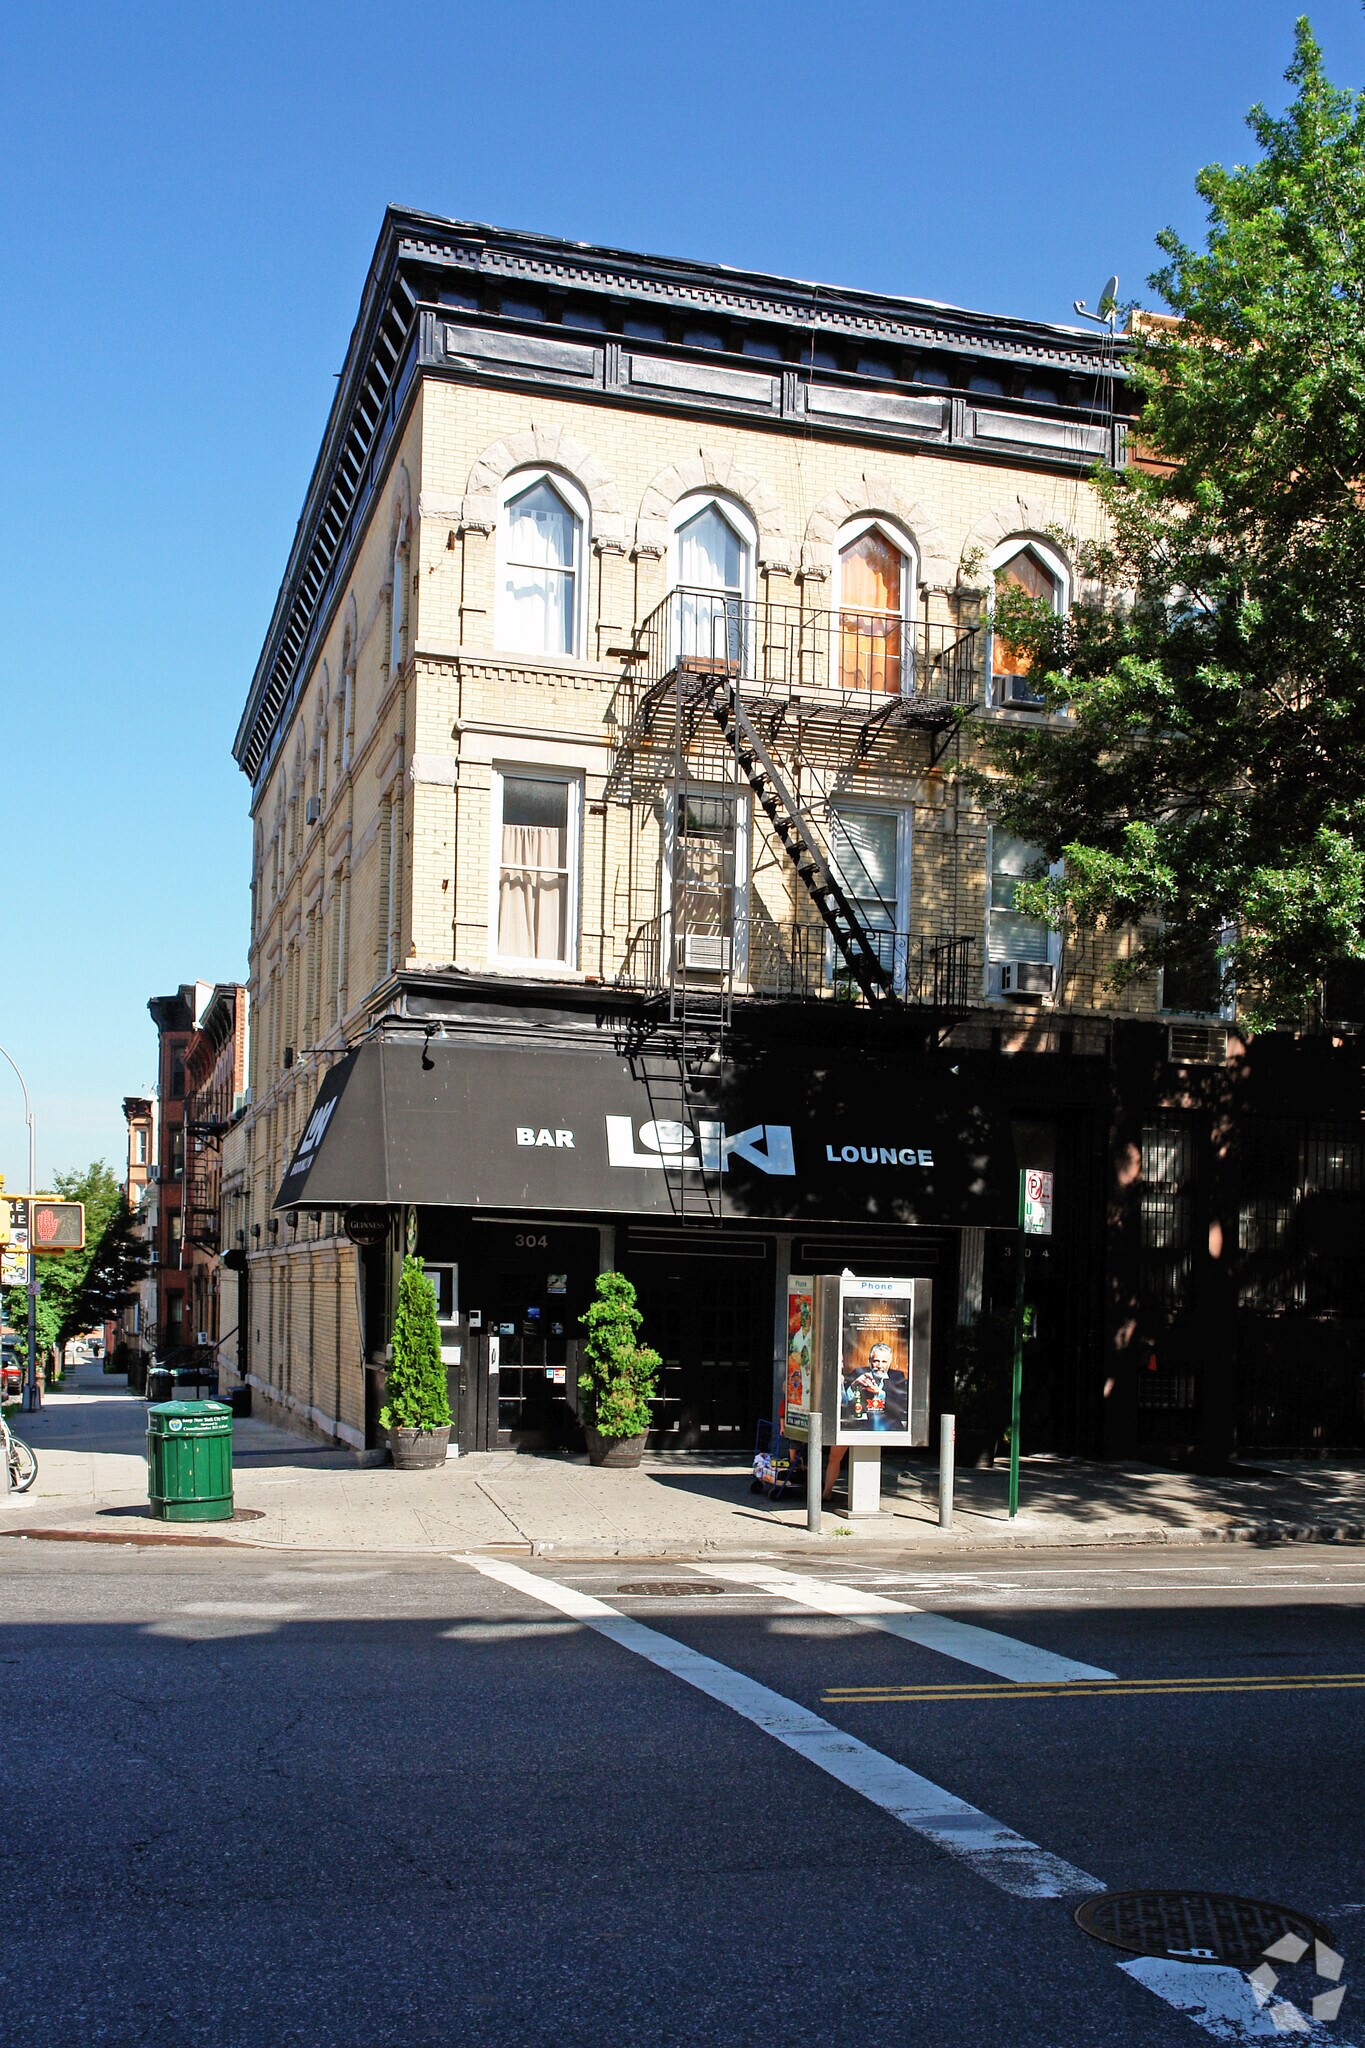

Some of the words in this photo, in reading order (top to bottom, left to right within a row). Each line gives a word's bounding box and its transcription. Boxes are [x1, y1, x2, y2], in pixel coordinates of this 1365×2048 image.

[516, 1127, 576, 1149] BAR
[825, 1144, 935, 1168] LOUNGE
[350, 1220, 385, 1230] GUINNESS
[515, 1234, 549, 1248] 304
[861, 1282, 893, 1290] Phone
